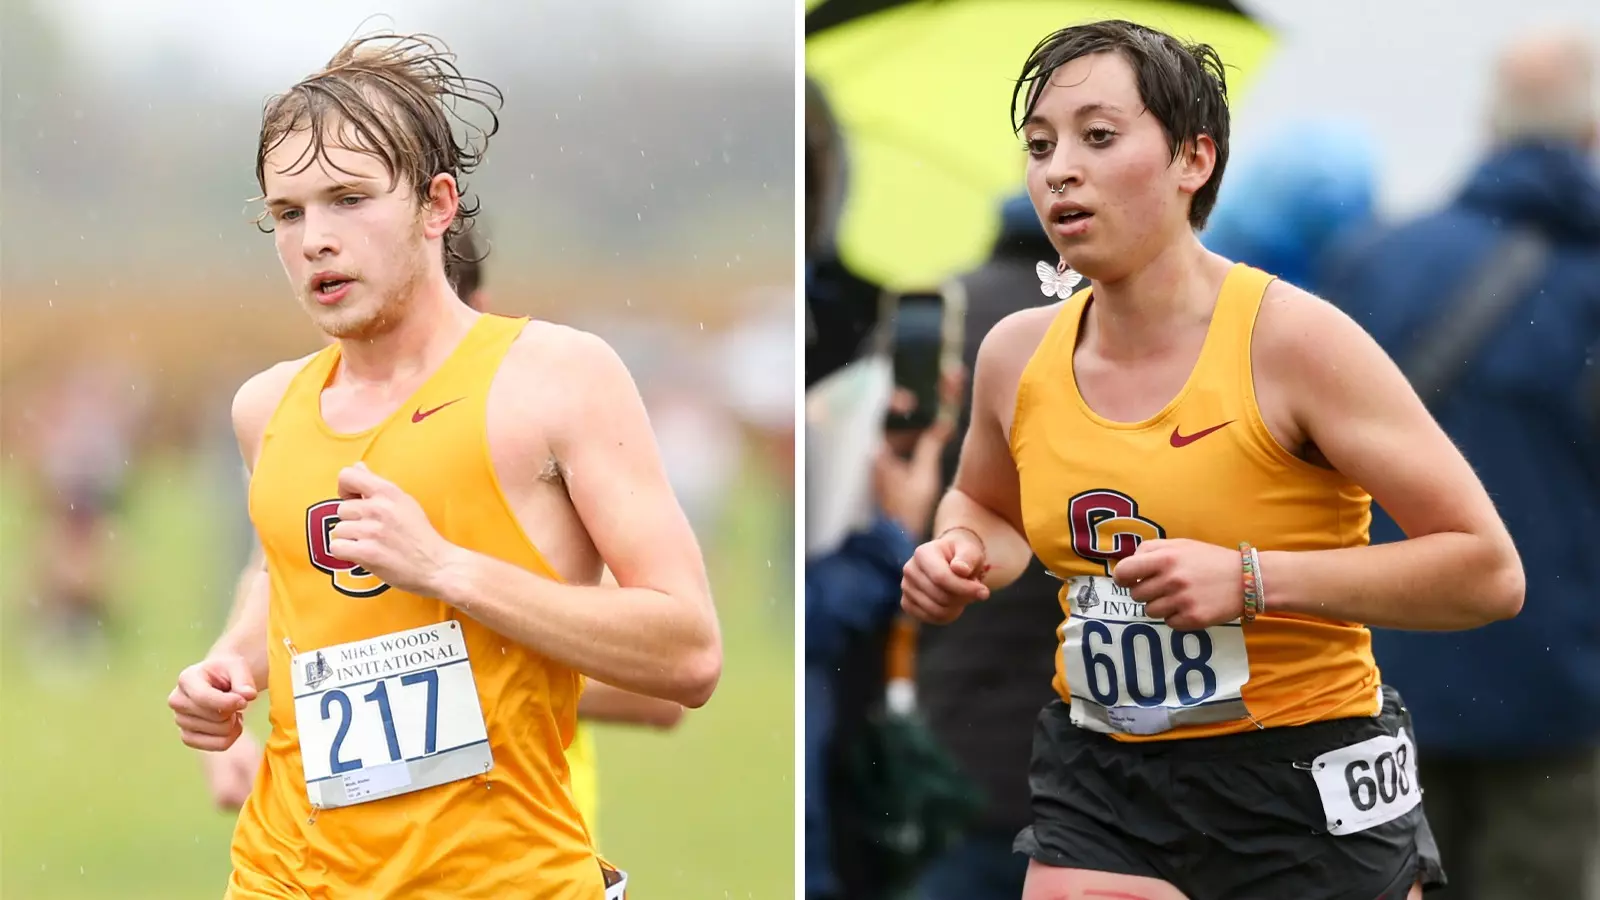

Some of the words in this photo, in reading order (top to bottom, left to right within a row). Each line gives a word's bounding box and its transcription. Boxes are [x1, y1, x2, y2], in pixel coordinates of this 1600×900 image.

[1111, 583, 1131, 597] MI
[336, 643, 459, 681] INVITATIONAL
[340, 643, 378, 662] MIKE
[380, 629, 440, 653] WOODS
[1082, 620, 1218, 708] 608
[320, 668, 440, 775] 217
[1344, 743, 1410, 812] 608
